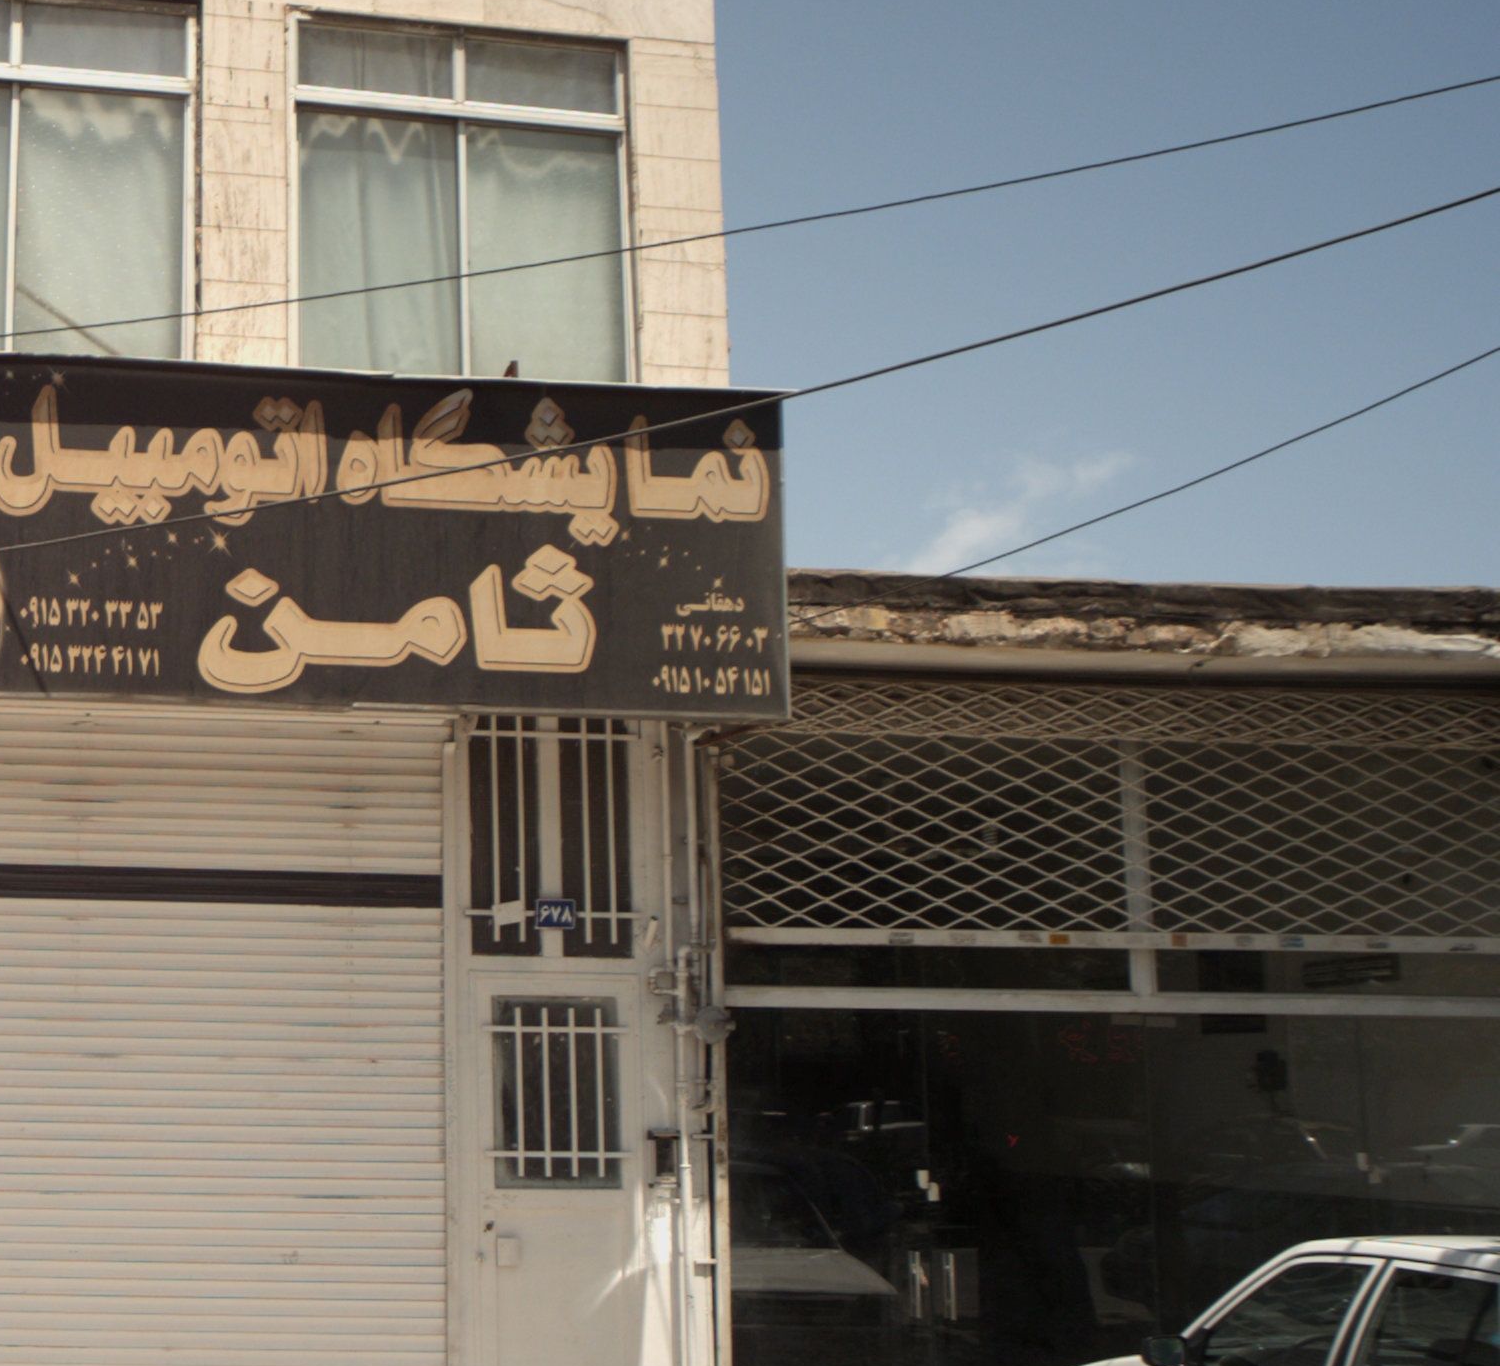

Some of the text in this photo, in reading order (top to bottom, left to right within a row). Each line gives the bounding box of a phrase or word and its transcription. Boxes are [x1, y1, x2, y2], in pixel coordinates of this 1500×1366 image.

[336, 388, 769, 546] نمایشگاه
[20, 595, 61, 627] ۰۹۱۵
[198, 544, 597, 693] ثامن
[676, 591, 745, 617] دهقانی
[20, 642, 63, 673] ۰۹۱۵
[539, 905, 573, 923] ۶۷۸
